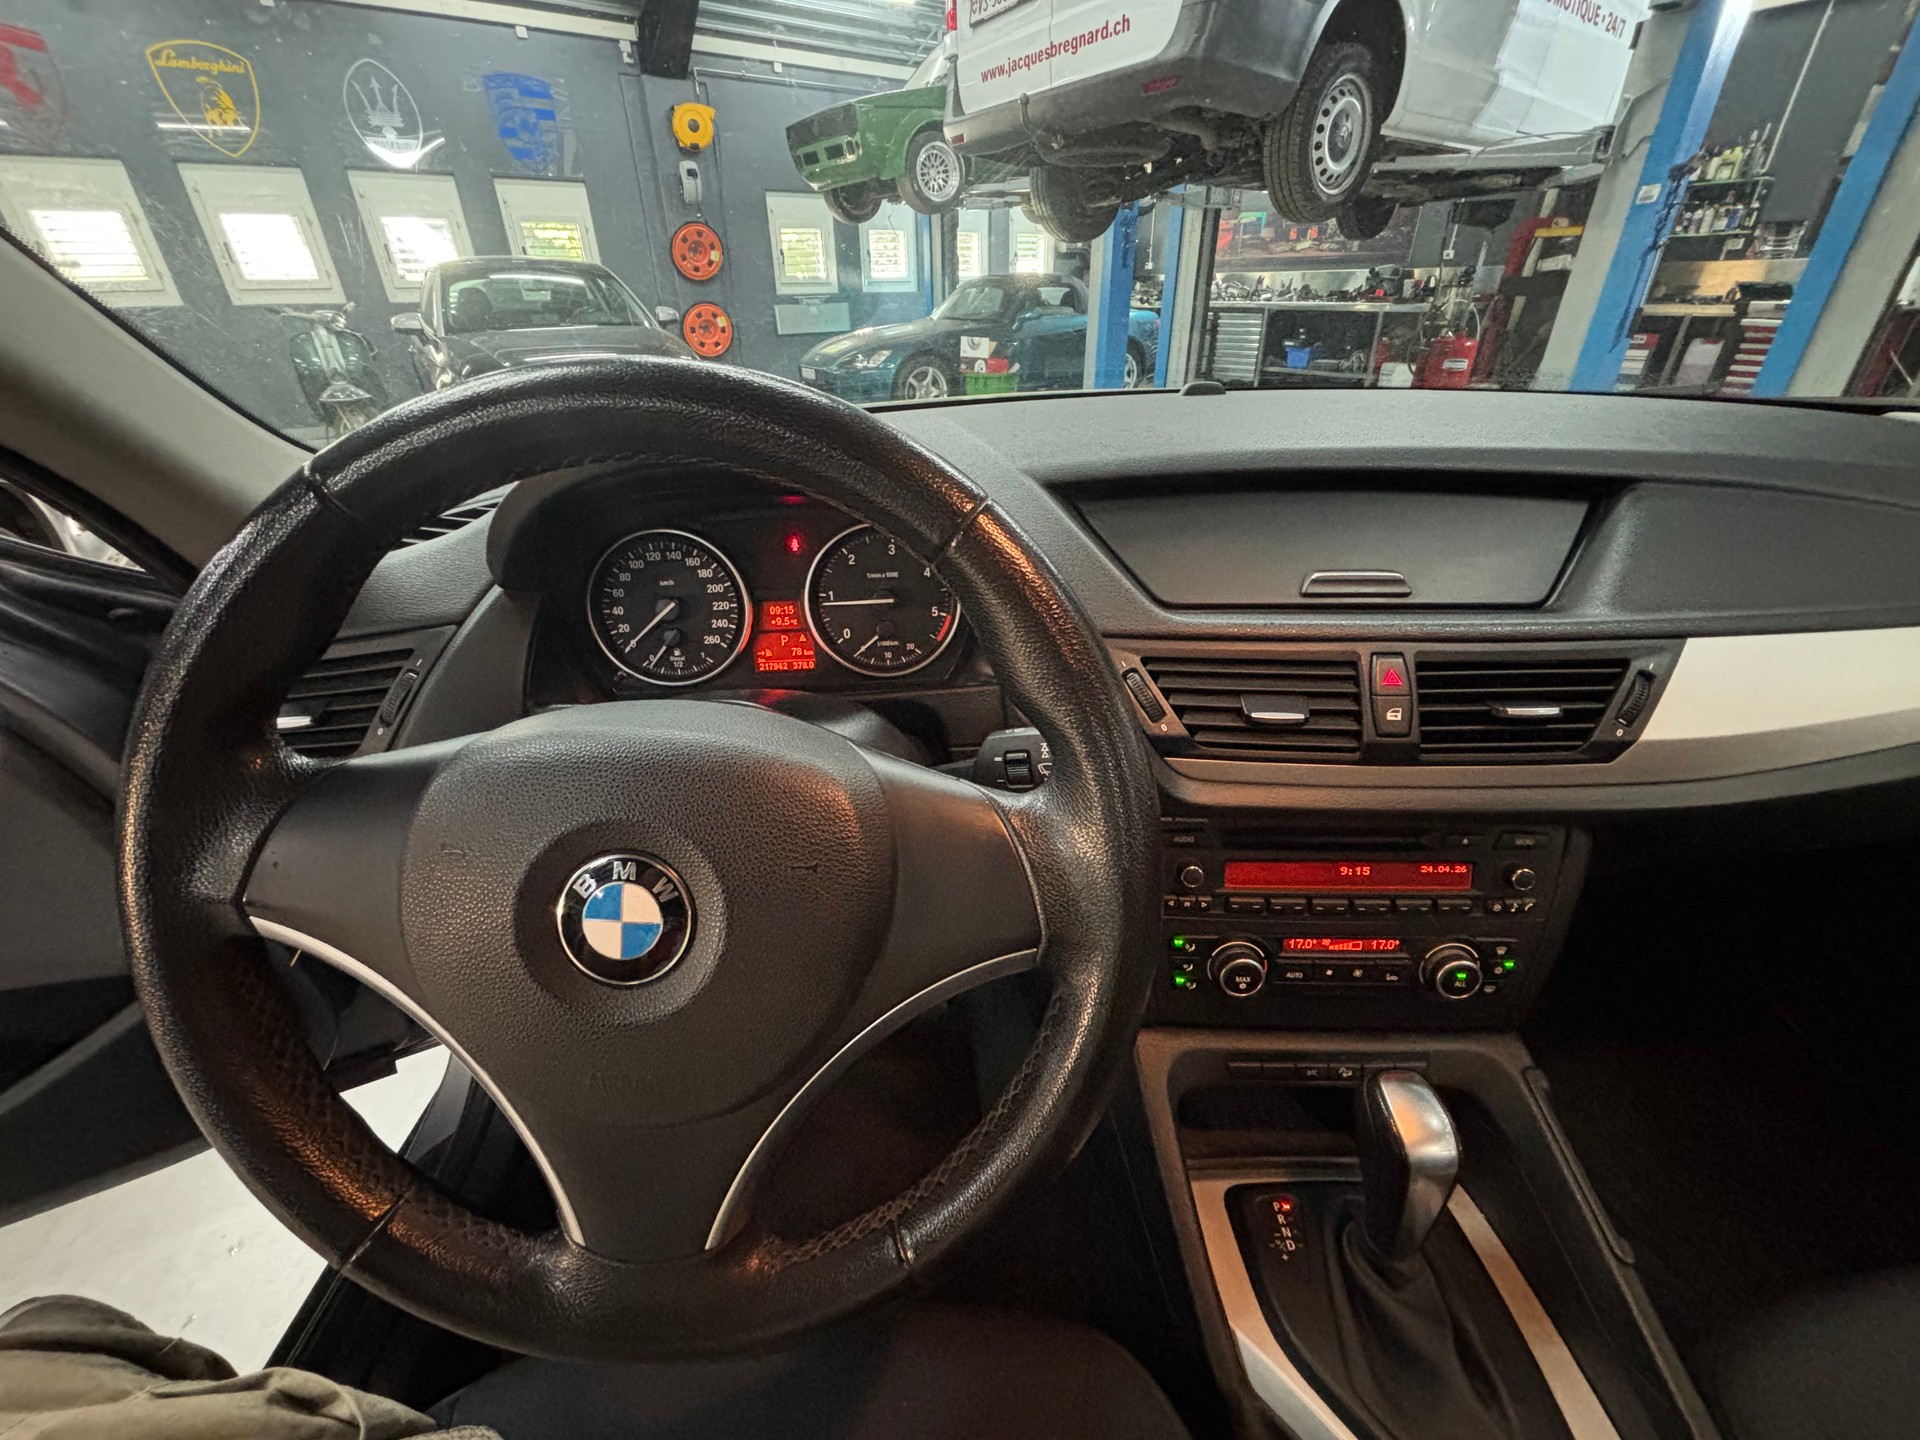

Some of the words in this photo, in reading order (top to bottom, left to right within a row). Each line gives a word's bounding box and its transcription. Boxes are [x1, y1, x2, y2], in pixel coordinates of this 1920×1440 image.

[1605, 12, 1627, 39] 24/7
[981, 13, 1131, 83] www.jacquesbregnard.ch
[154, 49, 245, 75] Lamborghini
[888, 544, 896, 555] 3
[645, 552, 661, 560] 120
[666, 551, 682, 560] 140
[847, 554, 856, 565] 2
[629, 560, 644, 569] 100
[685, 558, 700, 566] 160
[619, 572, 631, 581] 80
[697, 569, 713, 578] 180
[923, 567, 931, 577] 4
[612, 588, 624, 597] 60
[707, 584, 724, 593] 200
[828, 591, 834, 601] 1
[612, 606, 624, 615] 40
[713, 602, 730, 610] 220
[769, 605, 795, 615] 09:15
[931, 606, 939, 616] 5
[618, 624, 630, 633] 20
[711, 619, 728, 628] 240
[843, 628, 851, 639] 0
[704, 635, 720, 644] 260
[780, 634, 789, 646] P
[791, 647, 802, 656] 78
[759, 662, 788, 671] 217942
[792, 661, 815, 670] 378.0
[1340, 866, 1371, 876] 9:15
[1420, 865, 1468, 873] 24.04.26
[572, 860, 679, 903] BMW
[1272, 1201, 1280, 1212] P
[1277, 1214, 1287, 1225] R
[1281, 1226, 1292, 1237] N
[1286, 1239, 1296, 1251] D
